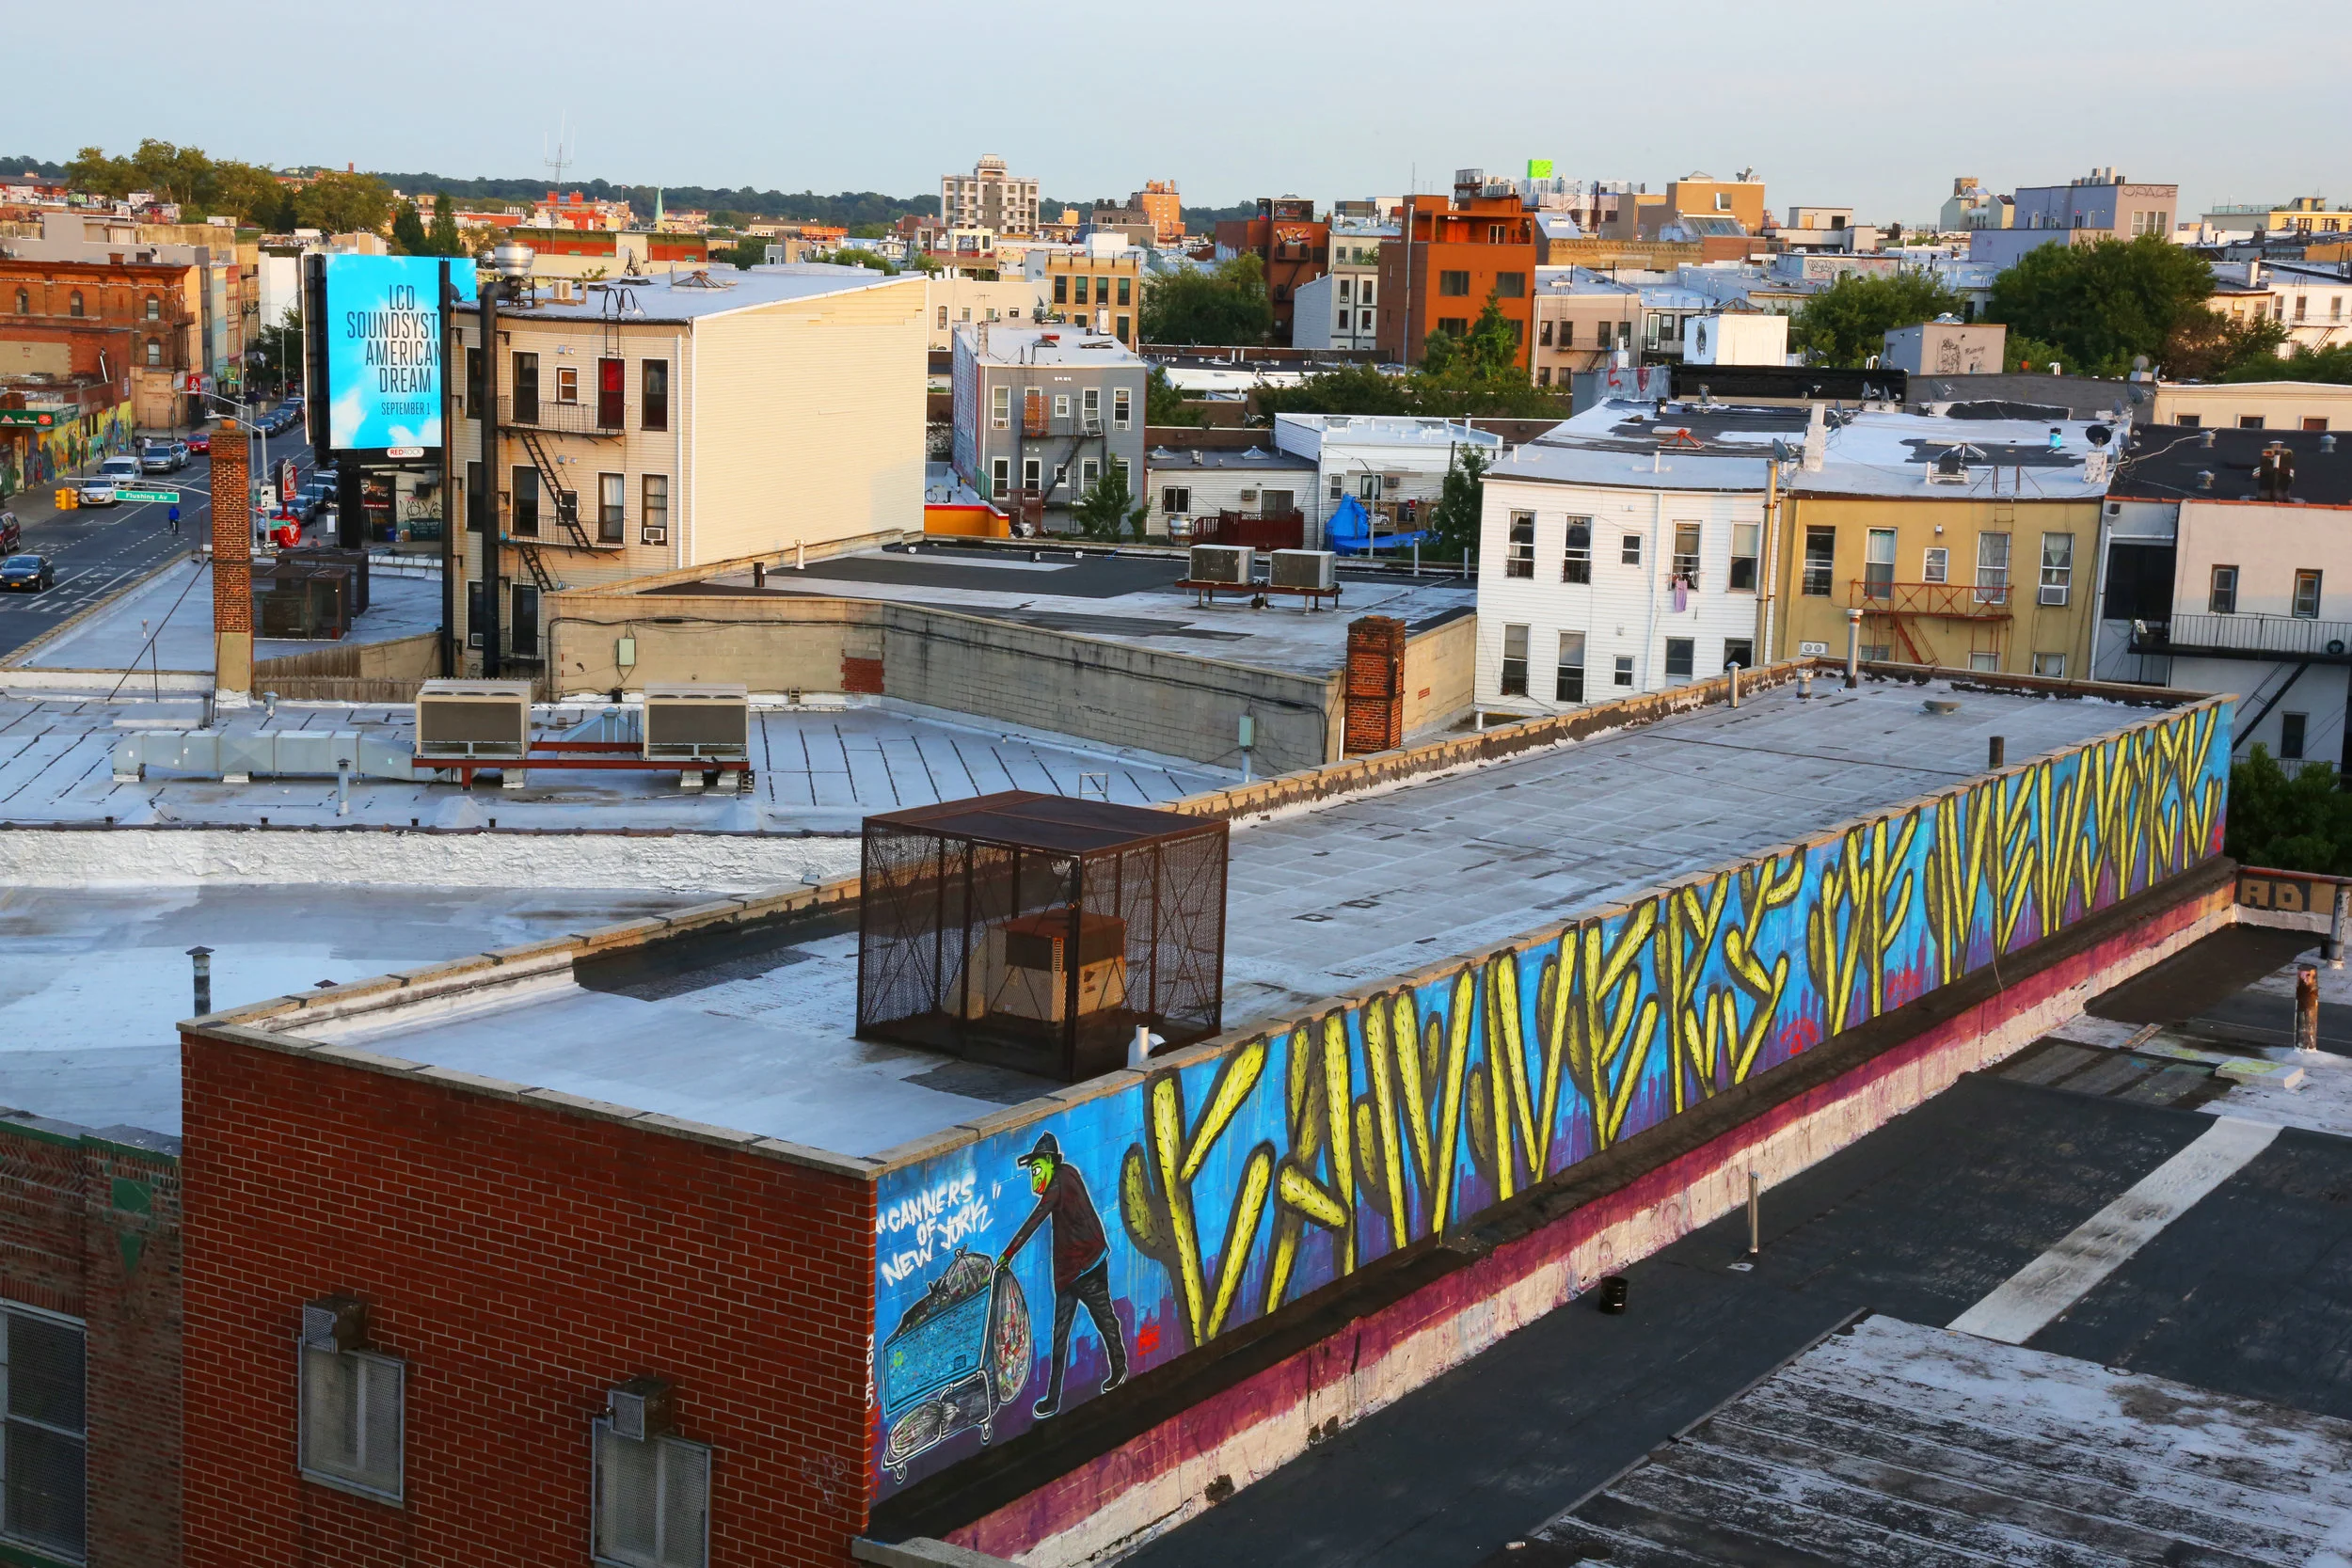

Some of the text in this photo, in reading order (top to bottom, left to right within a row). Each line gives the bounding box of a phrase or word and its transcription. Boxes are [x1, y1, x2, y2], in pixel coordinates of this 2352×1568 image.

[389, 284, 415, 310] LCD
[346, 311, 437, 339] SOUNDSYST
[379, 368, 431, 393] DREAM
[381, 402, 430, 416] SEPTEMBER 1
[125, 492, 155, 500] Flushing
[916, 1216, 937, 1246] OF
[881, 1237, 934, 1287] NEW
[865, 1334, 875, 1411] 2015
